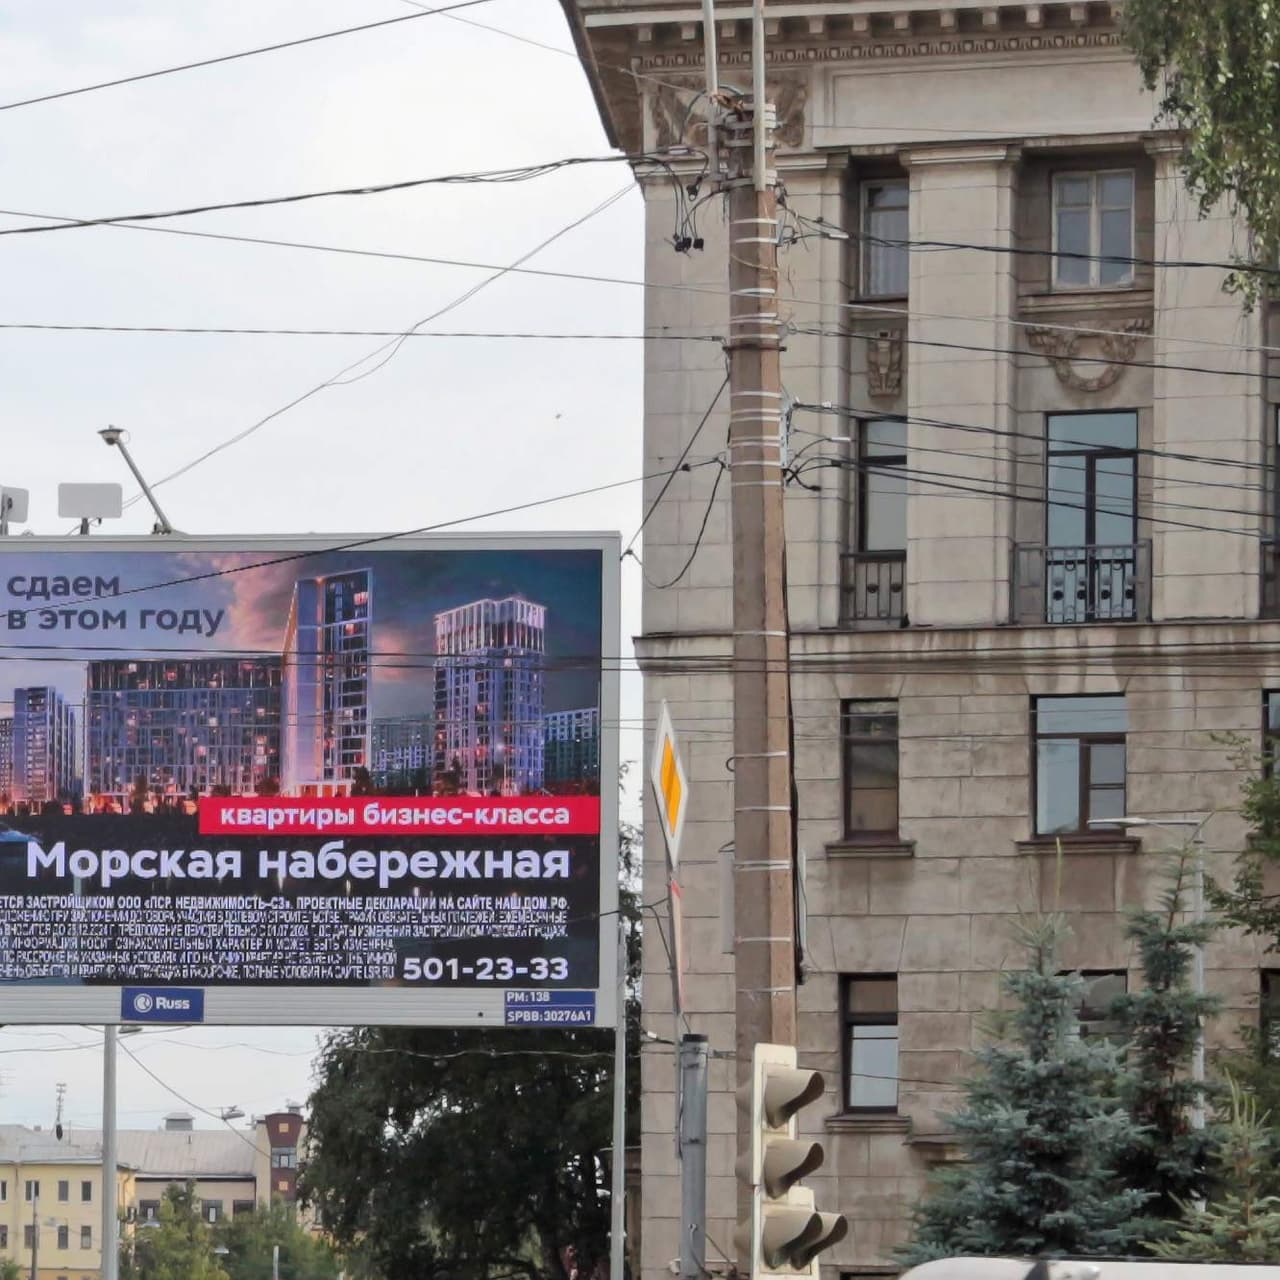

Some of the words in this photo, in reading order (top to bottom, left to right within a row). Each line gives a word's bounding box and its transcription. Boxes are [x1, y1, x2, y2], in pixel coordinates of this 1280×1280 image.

[6, 576, 120, 599] сдаем
[7, 609, 26, 630] в
[38, 608, 127, 630] этом
[141, 608, 225, 638] году
[221, 806, 355, 829] квартиры
[363, 803, 570, 827] бизнес-класса
[27, 841, 241, 887] Морская
[259, 840, 570, 888] набережная
[26, 896, 114, 910] ЗАСТРОЙЩИКОМ
[117, 896, 141, 910] ООО
[296, 897, 363, 910] ПРОЕКТНЫЕ
[365, 897, 436, 910] ДЕКЛАРАЦИИ
[439, 897, 455, 910] НА
[457, 897, 492, 910] САЙТЕ
[402, 957, 569, 981] 501-23-33
[155, 996, 190, 1010] Russ
